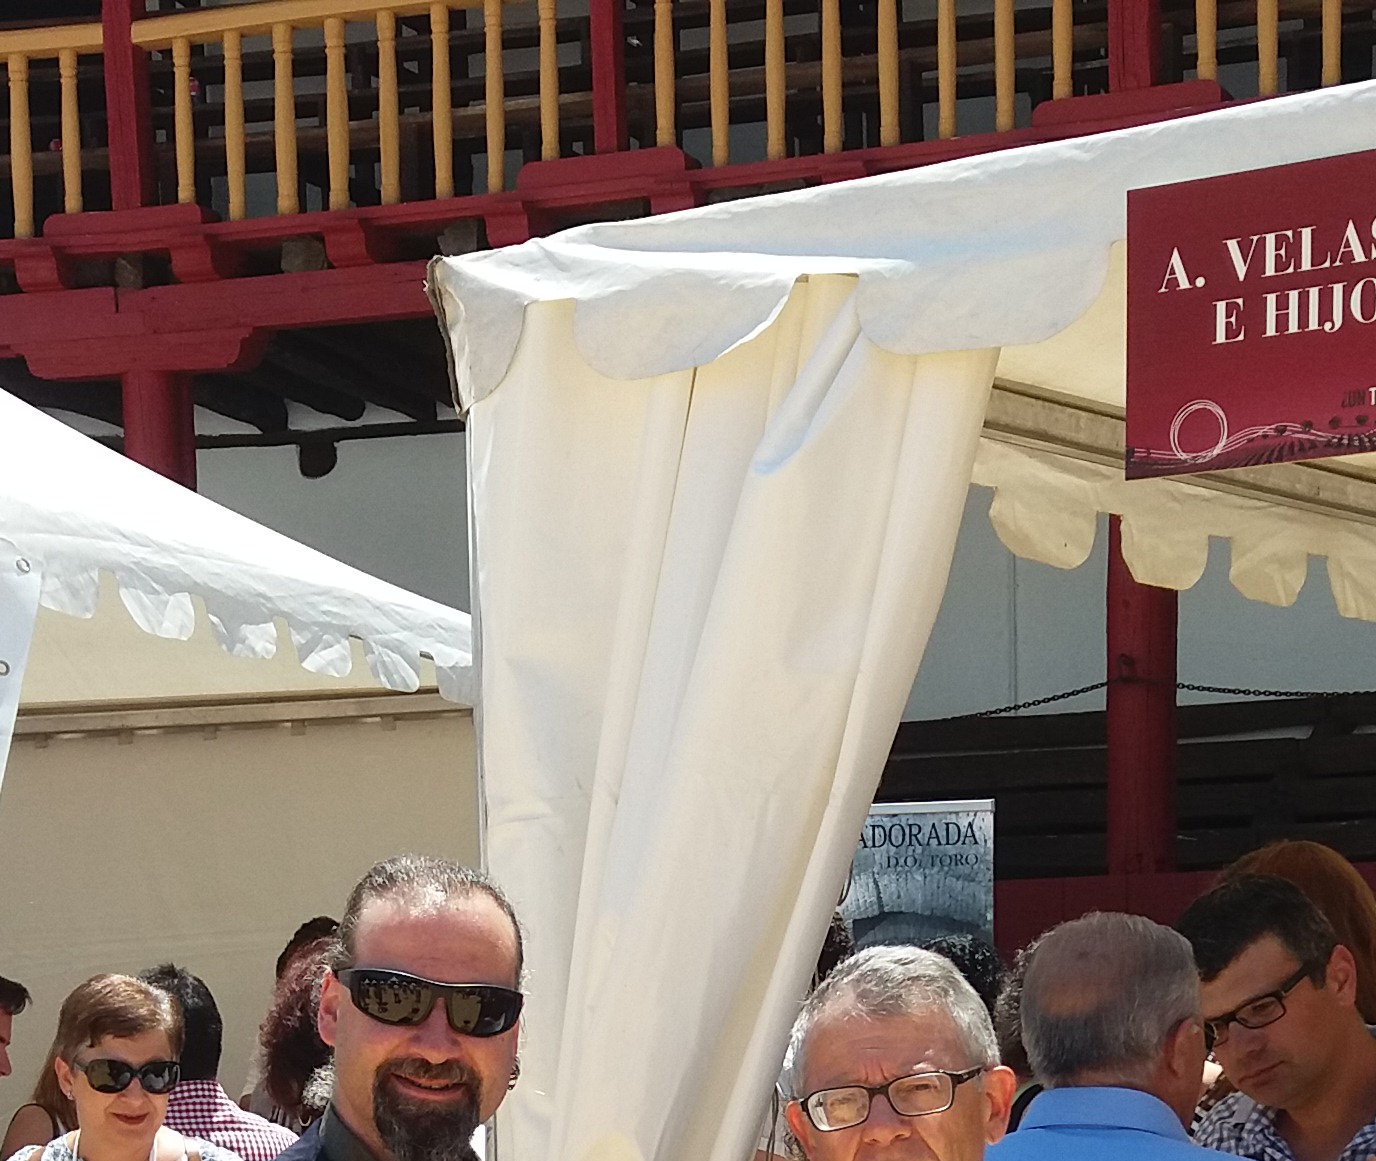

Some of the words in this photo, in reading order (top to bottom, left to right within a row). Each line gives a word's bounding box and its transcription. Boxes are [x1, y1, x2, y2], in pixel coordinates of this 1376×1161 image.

[1158, 247, 1206, 294] A.
[1212, 298, 1246, 346] E
[929, 853, 979, 868] TORO
